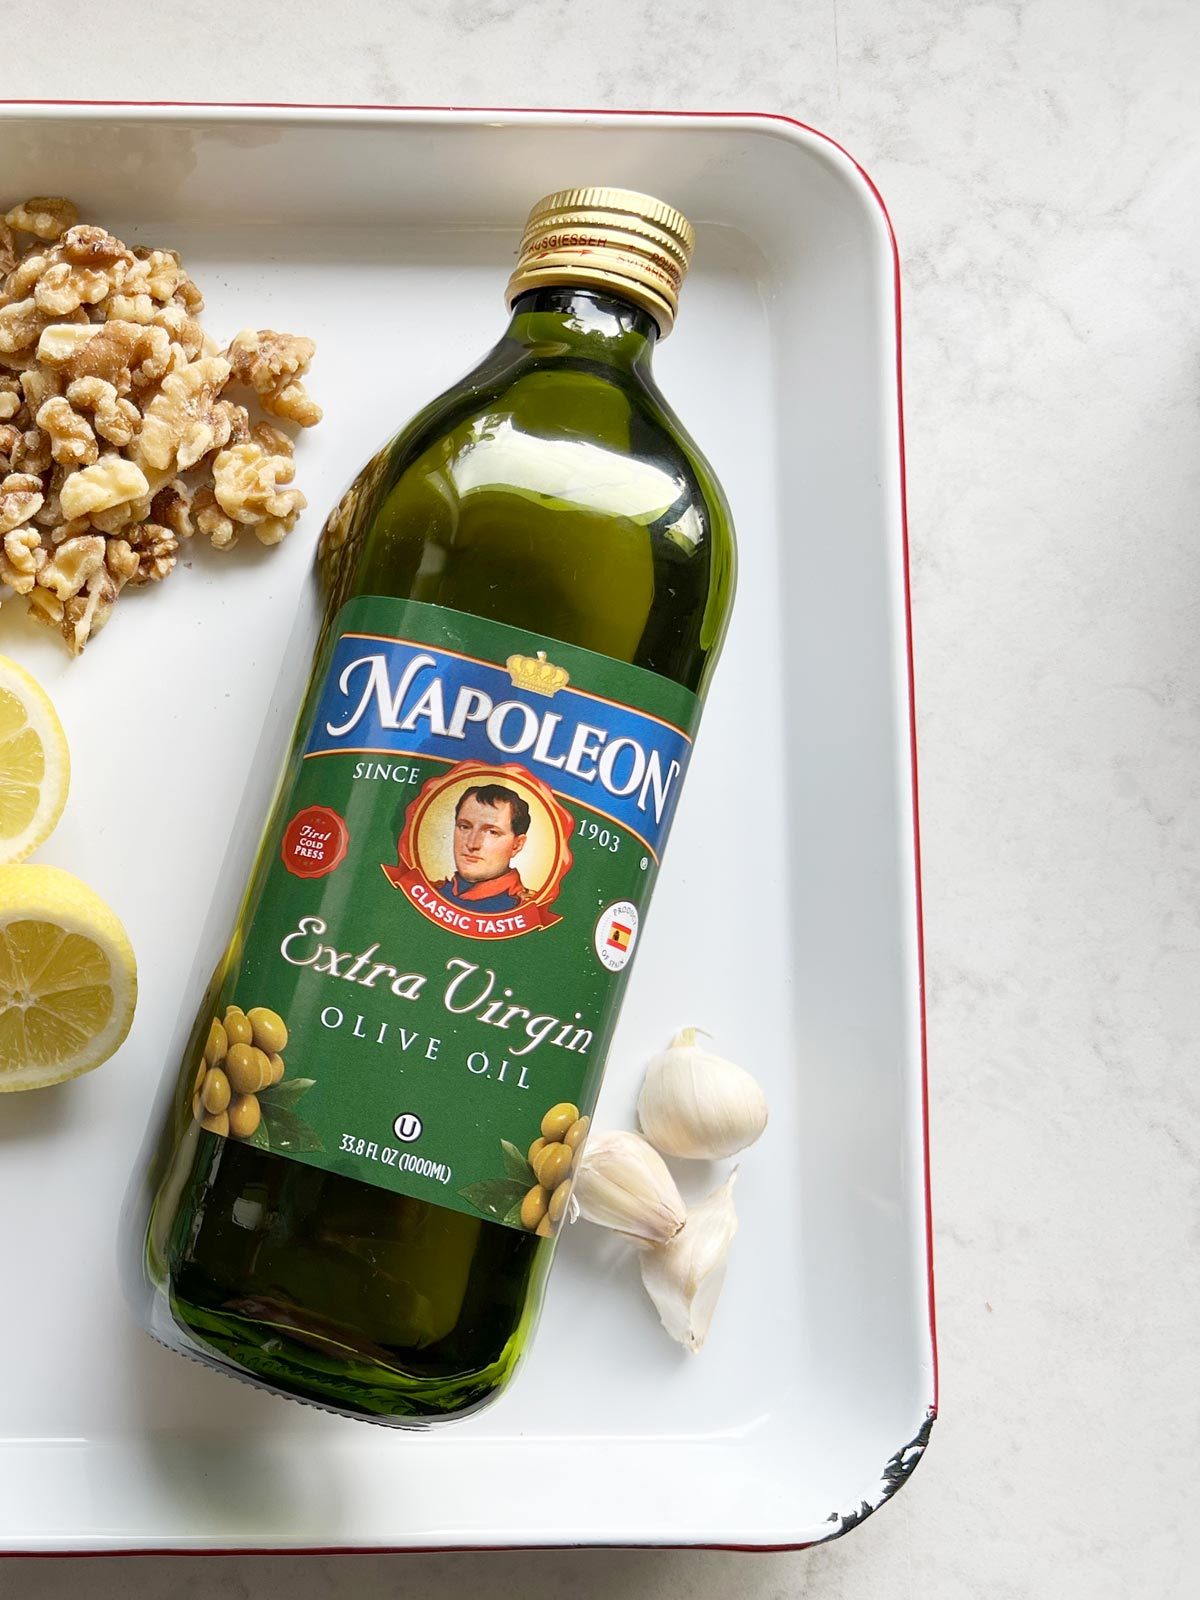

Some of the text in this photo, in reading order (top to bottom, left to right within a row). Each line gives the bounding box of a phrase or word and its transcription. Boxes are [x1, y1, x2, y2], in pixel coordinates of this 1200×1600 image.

[327, 654, 680, 824] NAPOLEON
[353, 762, 620, 853] SINCE 1903
[294, 845, 325, 861] PRESS
[299, 837, 324, 851] COLD
[410, 884, 527, 934] CLASSIC TASTE
[280, 916, 594, 1056] Extra Virgin
[319, 1005, 531, 1091] OLIVE OIL
[339, 1133, 452, 1184] 33.8 FL OZ (1000ML)
